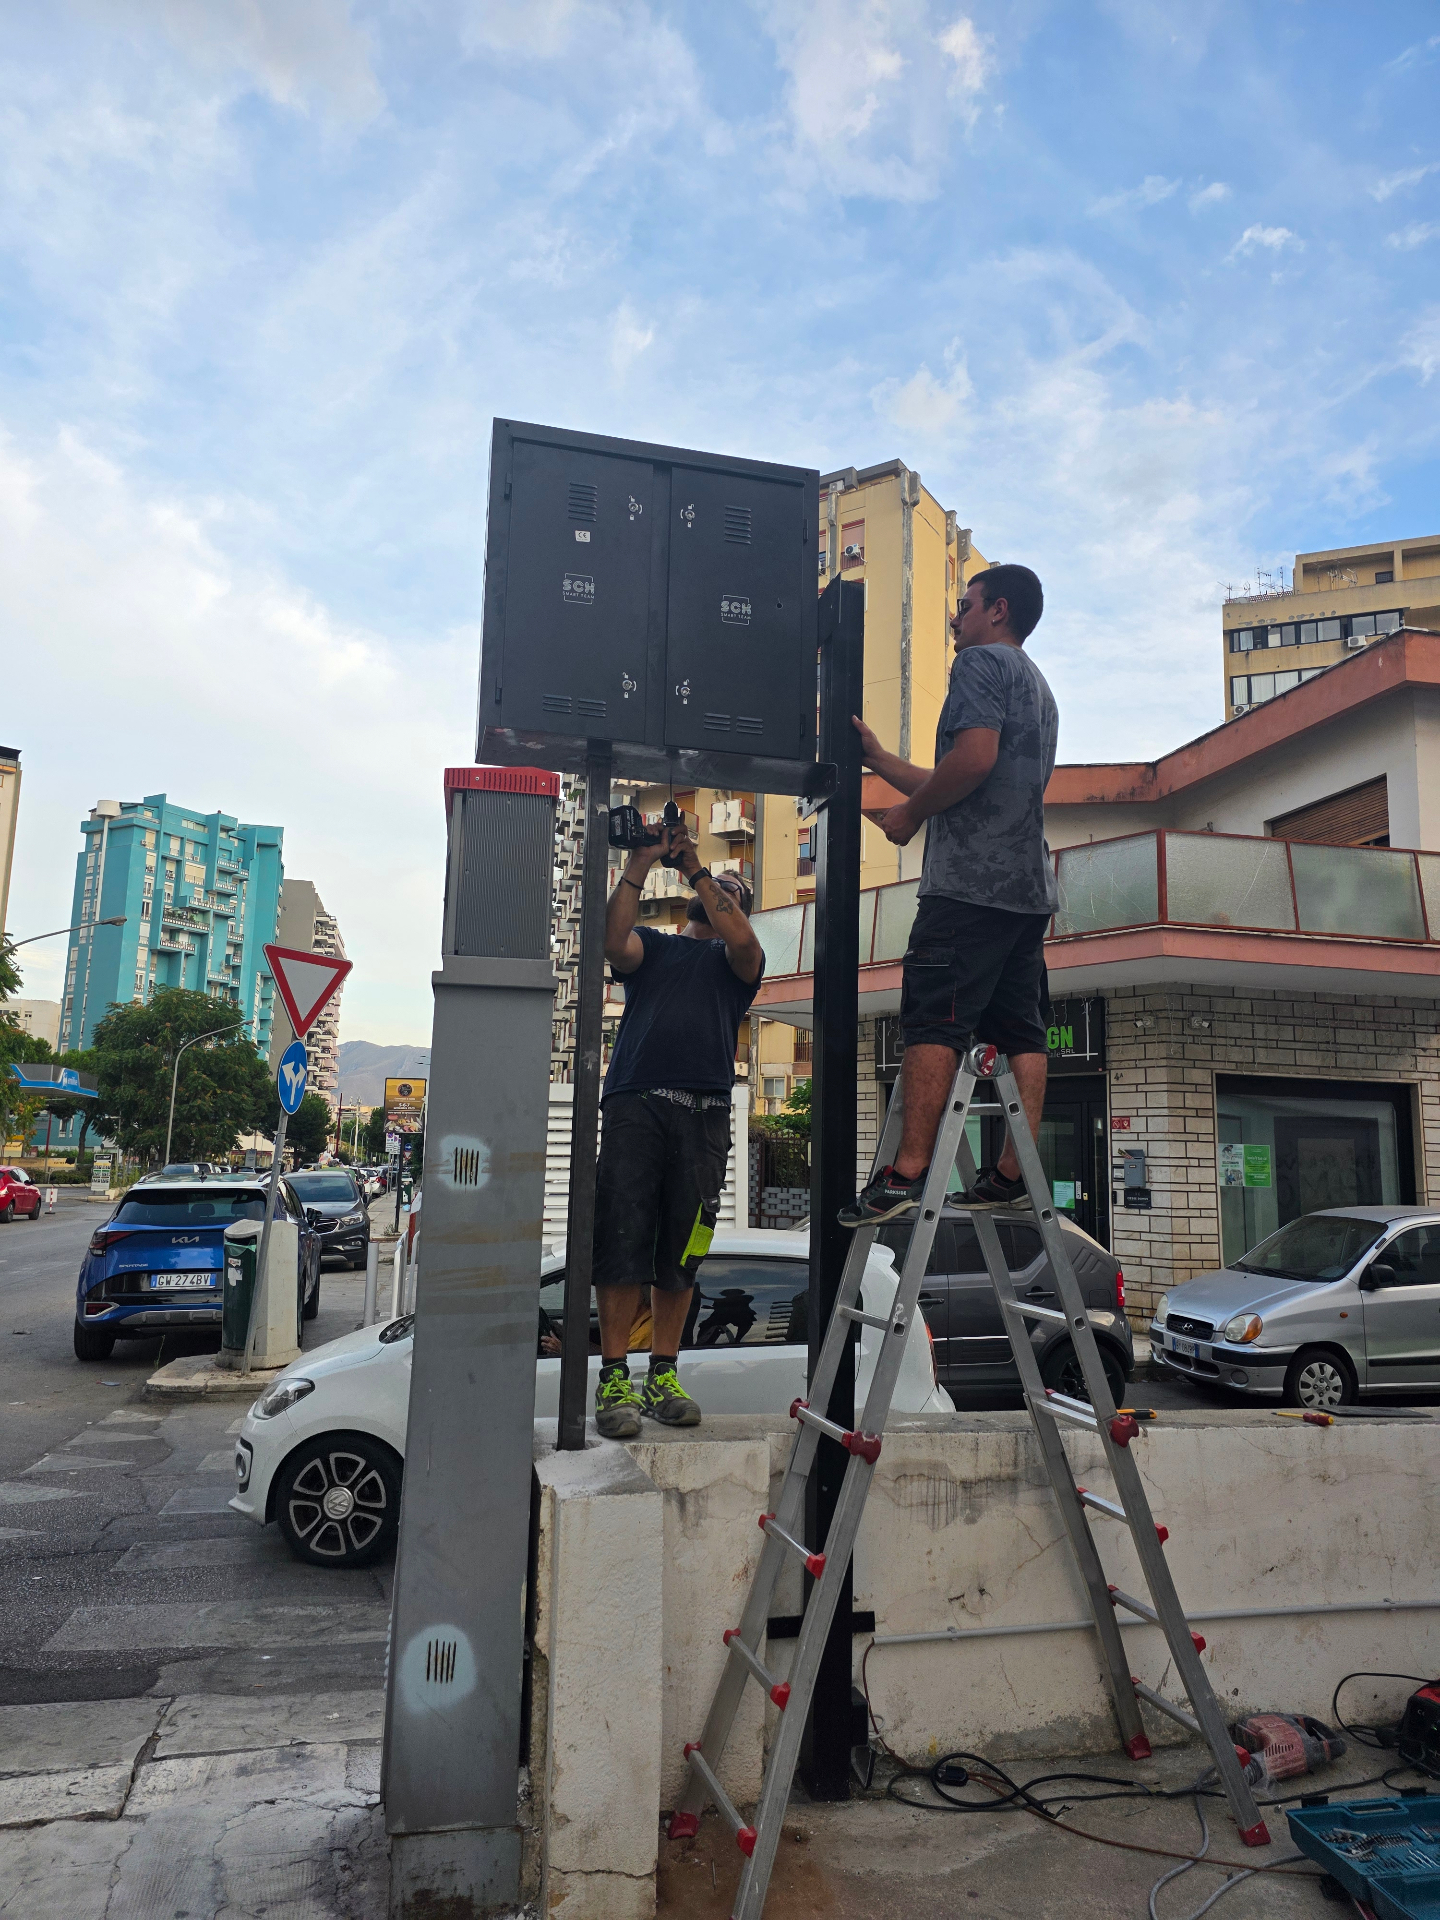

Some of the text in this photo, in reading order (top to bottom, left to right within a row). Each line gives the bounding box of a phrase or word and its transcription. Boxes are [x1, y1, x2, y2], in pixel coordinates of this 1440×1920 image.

[562, 578, 595, 595] SCH
[721, 600, 751, 615] SCH
[1046, 1025, 1074, 1050] GN
